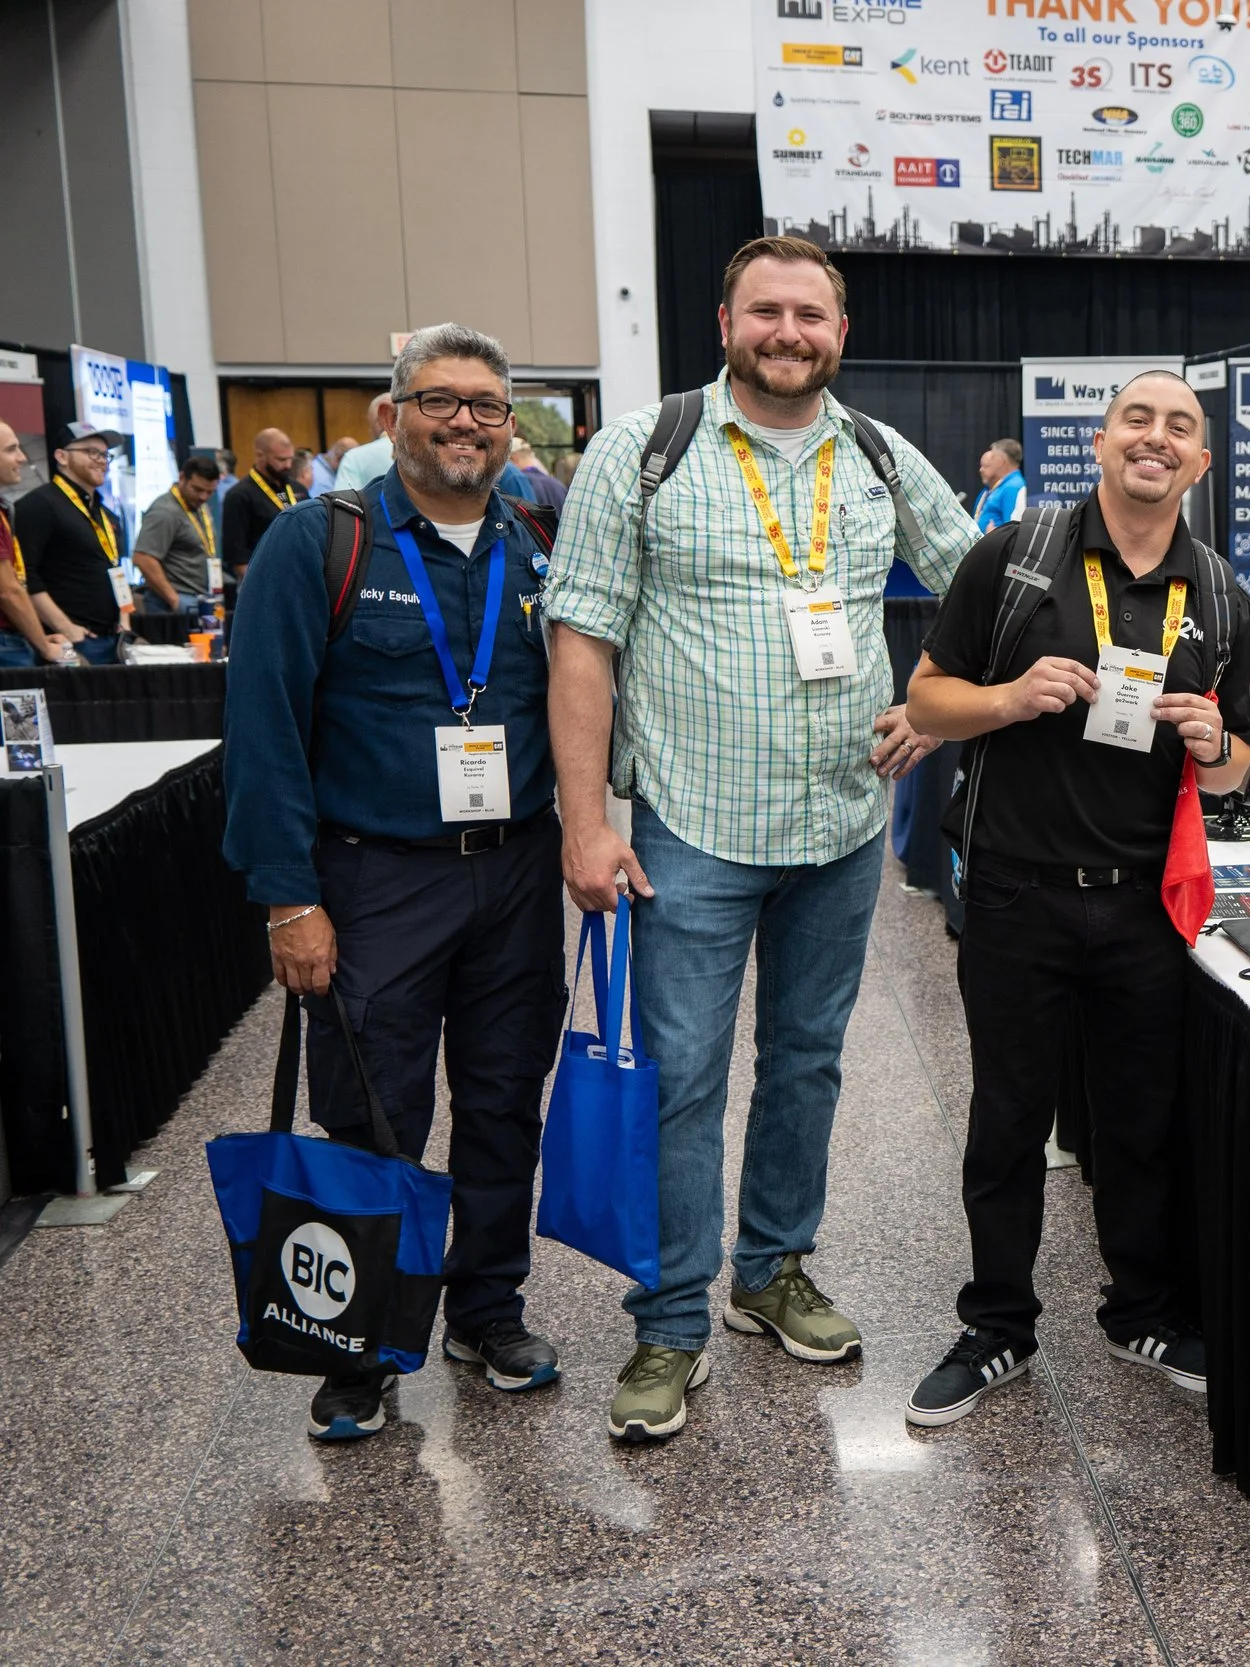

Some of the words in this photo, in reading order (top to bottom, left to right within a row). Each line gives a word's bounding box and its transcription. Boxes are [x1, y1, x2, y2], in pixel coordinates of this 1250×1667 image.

[833, 6, 905, 25] EXPO
[985, 0, 1137, 24] THANK
[1038, 27, 1058, 42] To
[1063, 28, 1086, 44] all
[1092, 34, 1121, 46] our
[1127, 32, 1205, 50] Sponsors
[920, 55, 970, 77] kent
[1009, 54, 1056, 72] TEADIT
[1070, 66, 1102, 88] 3S
[1130, 62, 1173, 89] ITS
[889, 112, 932, 122] BOLTING
[935, 114, 982, 124] SYSTEMS
[772, 149, 823, 160] SUNBELT
[1057, 149, 1123, 167] TECHMAR
[897, 162, 933, 174] AAIT
[1072, 384, 1105, 401] Way
[1040, 426, 1076, 438] SINCE
[1047, 445, 1079, 457] BEEN
[1040, 463, 1081, 475] BROAD
[1043, 481, 1094, 493] FACILITY
[1121, 684, 1138, 692] Jake
[290, 1242, 351, 1303] BIC
[263, 1302, 367, 1354] ALLIANCE
